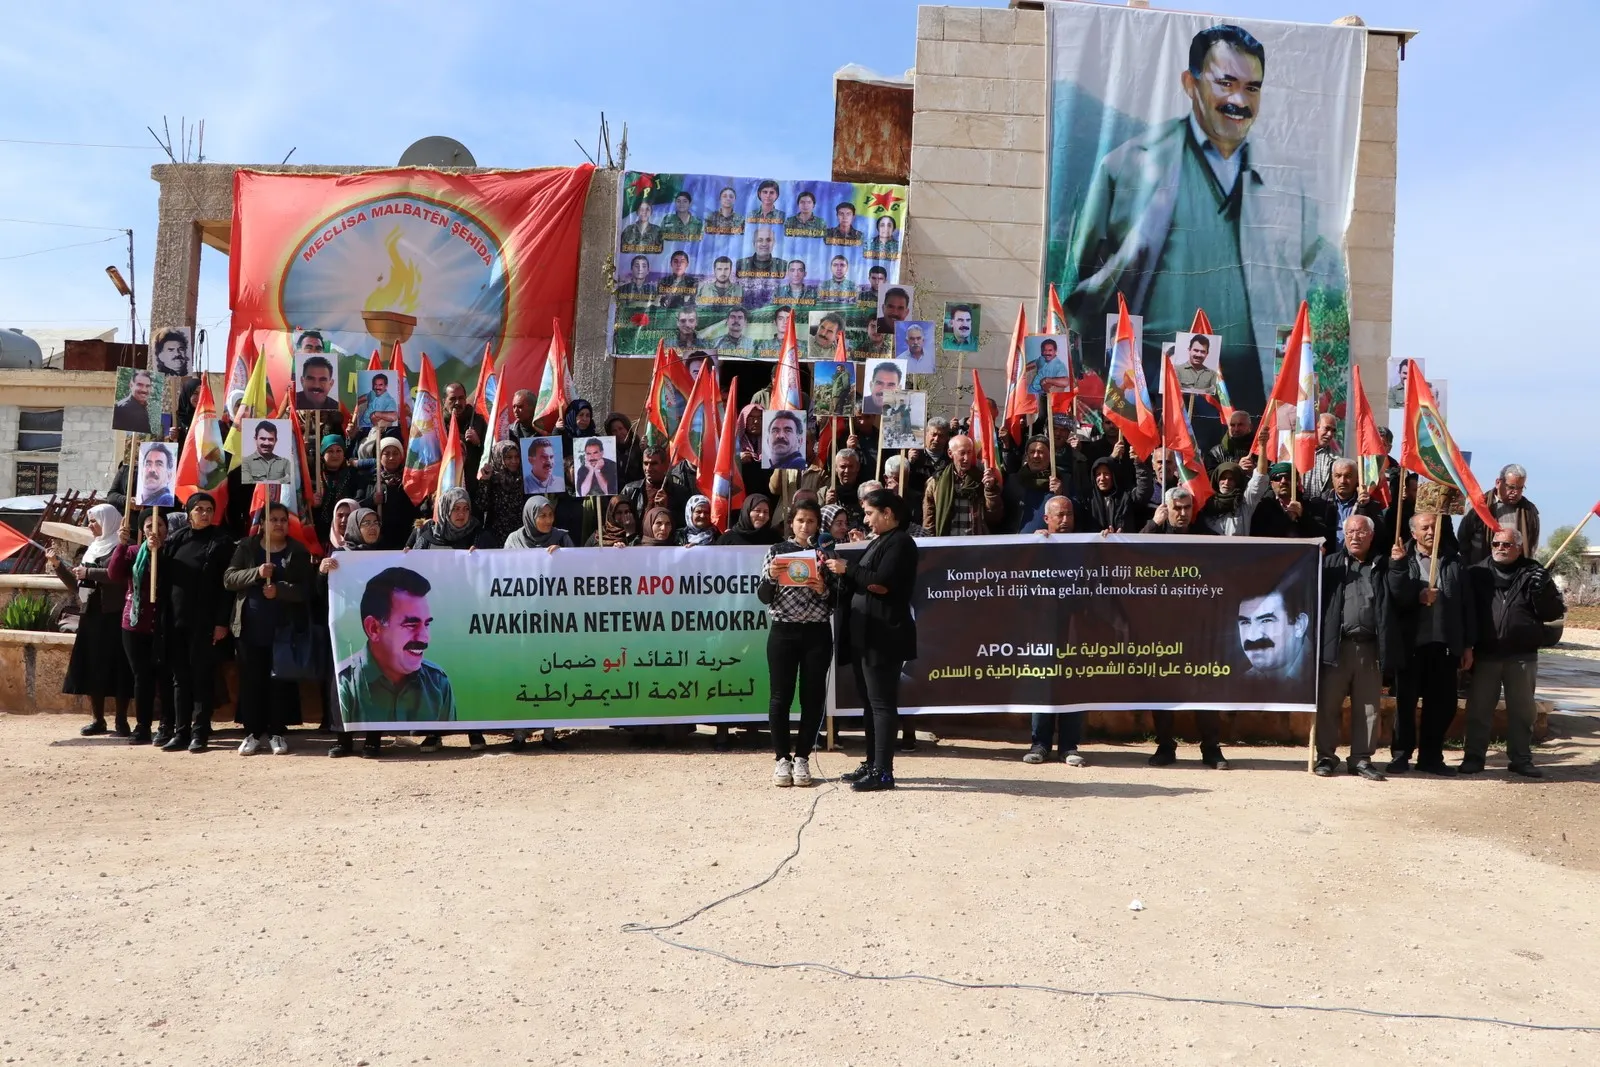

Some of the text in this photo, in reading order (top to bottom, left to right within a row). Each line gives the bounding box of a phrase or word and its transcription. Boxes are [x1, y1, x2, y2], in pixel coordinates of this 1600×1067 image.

[863, 195, 901, 214] YPG
[946, 565, 1202, 583] Komploya navneteweyî ya li dijî Rêber APO,
[489, 574, 568, 597] AZADÎYA
[573, 576, 632, 596] REBER
[637, 575, 675, 595] APO
[927, 583, 1224, 601] komployek li dijî vîna gelan, demokrasî û aşitiyê ye
[469, 609, 578, 635] AVAKÎRÎNA
[584, 611, 666, 633] NETEWA
[976, 641, 1183, 659] المؤامرة الدولية على القائد APO
[539, 647, 742, 675] حرية القائد آبو ضمان
[928, 660, 1231, 681] مؤامرة على إرادة الشعوب و الديمقراطية و السلام
[515, 678, 755, 708] لبناء الامة الديمقراطية
